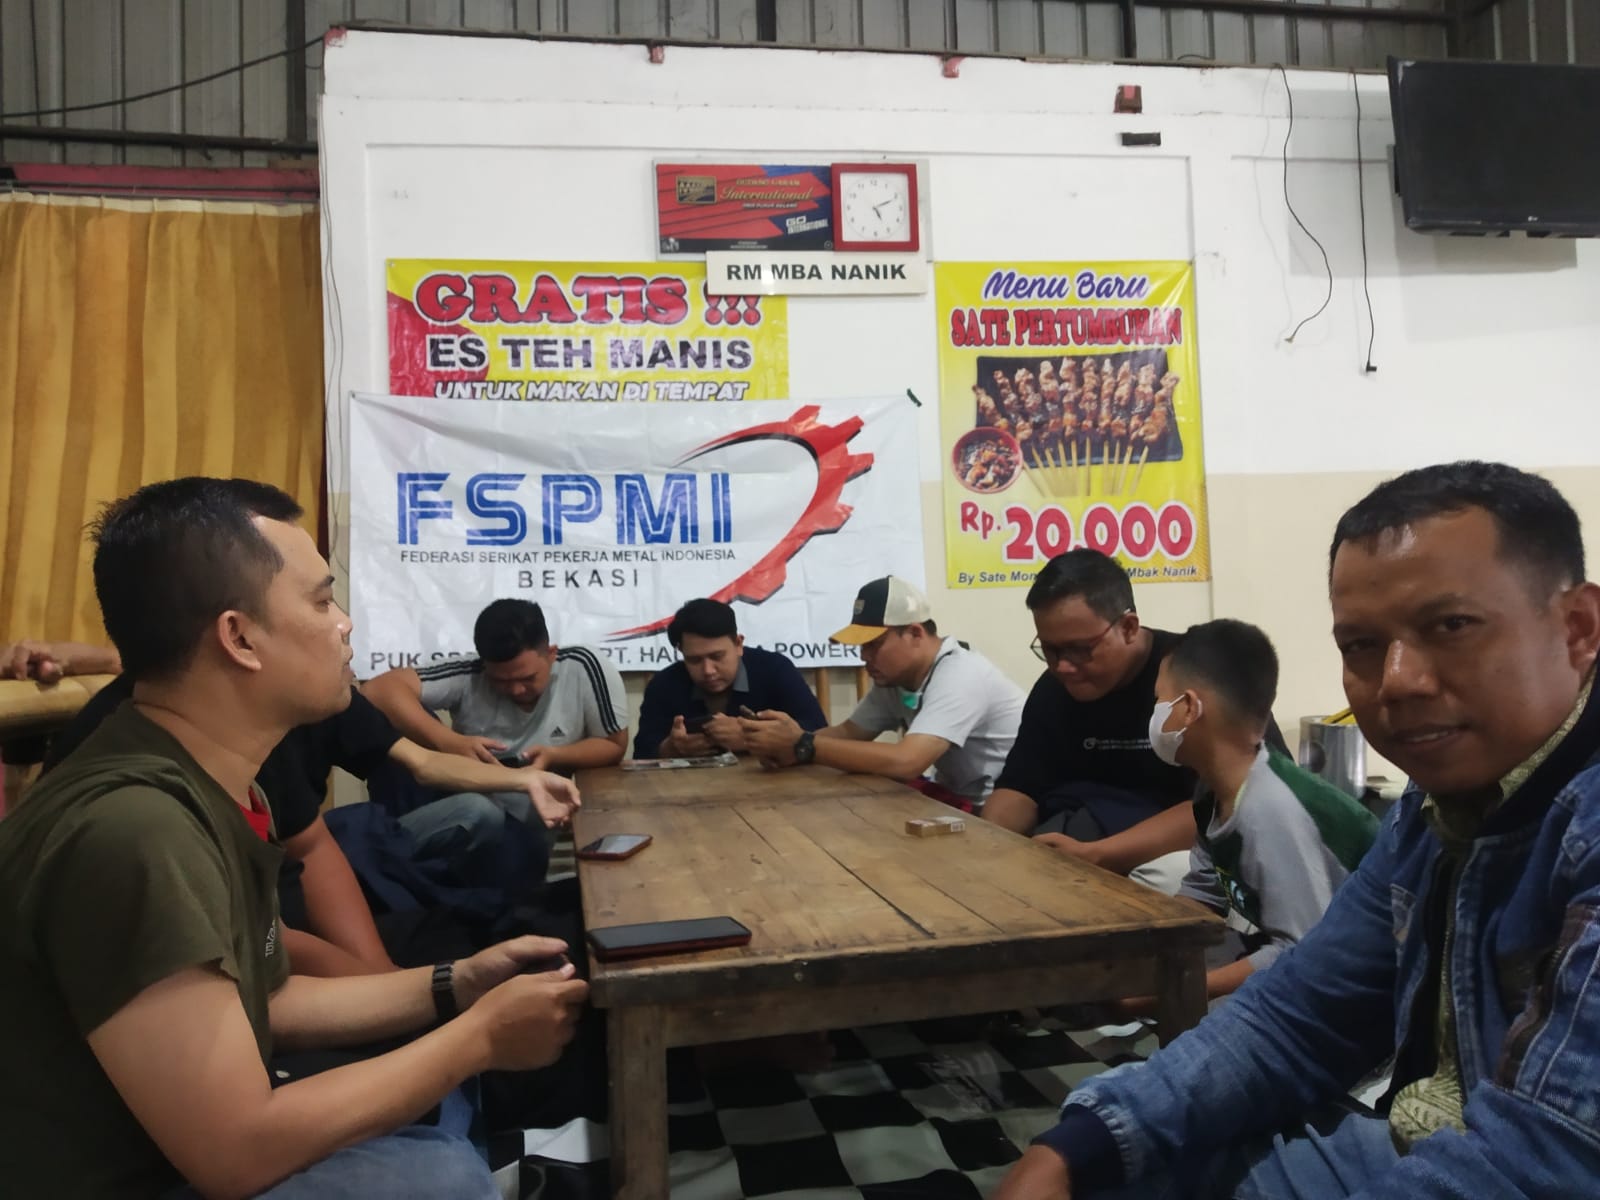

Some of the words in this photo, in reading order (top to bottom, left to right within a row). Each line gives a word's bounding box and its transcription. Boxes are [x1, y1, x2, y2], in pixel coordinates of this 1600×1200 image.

[726, 264, 762, 280] RM
[771, 264, 823, 280] MBA
[831, 264, 907, 280] NANIK
[983, 271, 1069, 299] Menu
[1076, 271, 1149, 298] Baru
[415, 274, 688, 325] GRATIS
[951, 308, 1011, 345] SATE
[429, 337, 487, 369] ES
[502, 338, 593, 369] TEH
[610, 339, 752, 369] MANIS
[434, 381, 521, 400] UNTUK
[525, 381, 619, 400] MAKAN
[621, 381, 649, 400] DI
[655, 381, 750, 400] TEMPAT
[396, 471, 733, 546] FSPMI
[960, 500, 1002, 540] Rp.
[400, 550, 475, 563] FEDERASI
[479, 551, 540, 563] SERIKAT
[544, 550, 609, 563] PEKERJA
[612, 550, 658, 562] METAL
[662, 549, 736, 561] INDONESIA
[518, 568, 639, 588] BEKASI
[958, 573, 975, 584] By
[980, 571, 1006, 582] Sate
[1162, 565, 1198, 577] Nanik
[774, 642, 859, 659] POWER
